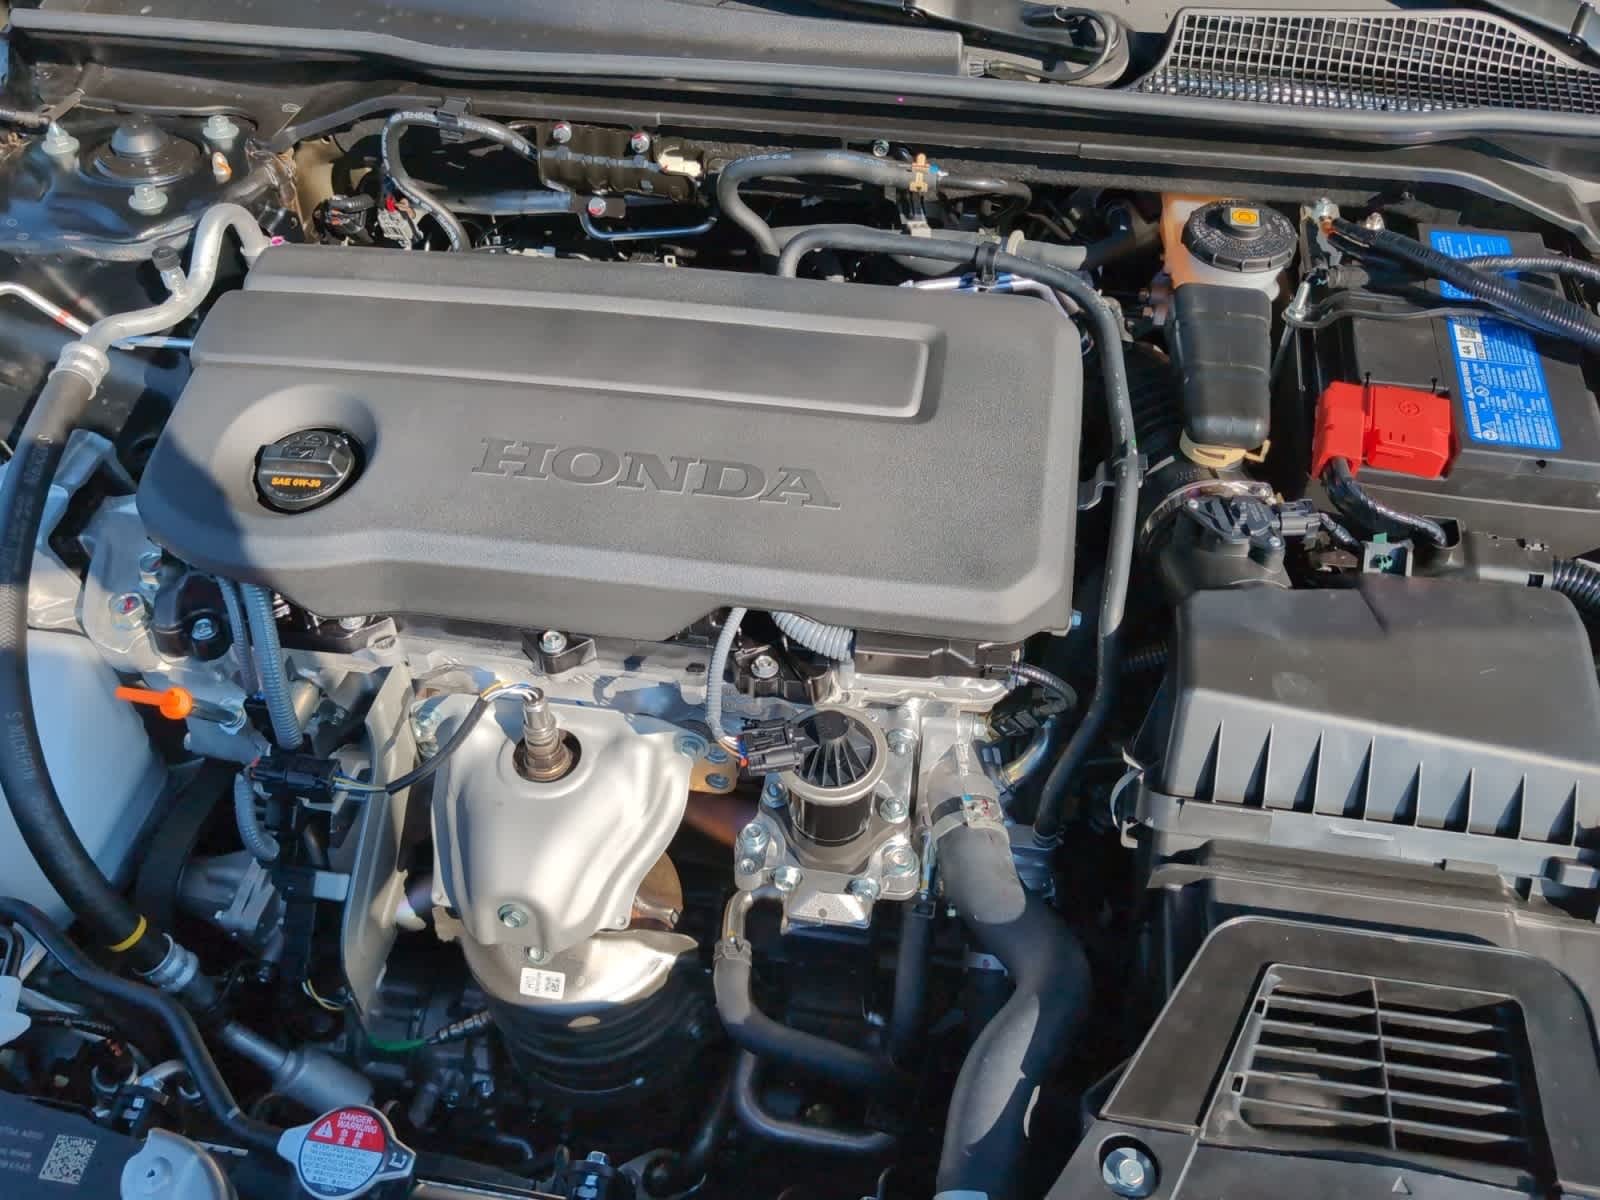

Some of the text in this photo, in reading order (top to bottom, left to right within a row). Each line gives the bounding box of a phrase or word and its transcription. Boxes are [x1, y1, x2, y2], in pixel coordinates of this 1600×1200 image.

[472, 437, 841, 510] HONDA
[272, 477, 292, 486] SAE
[339, 1111, 374, 1125] DANGER
[337, 1119, 378, 1134] WARNING
